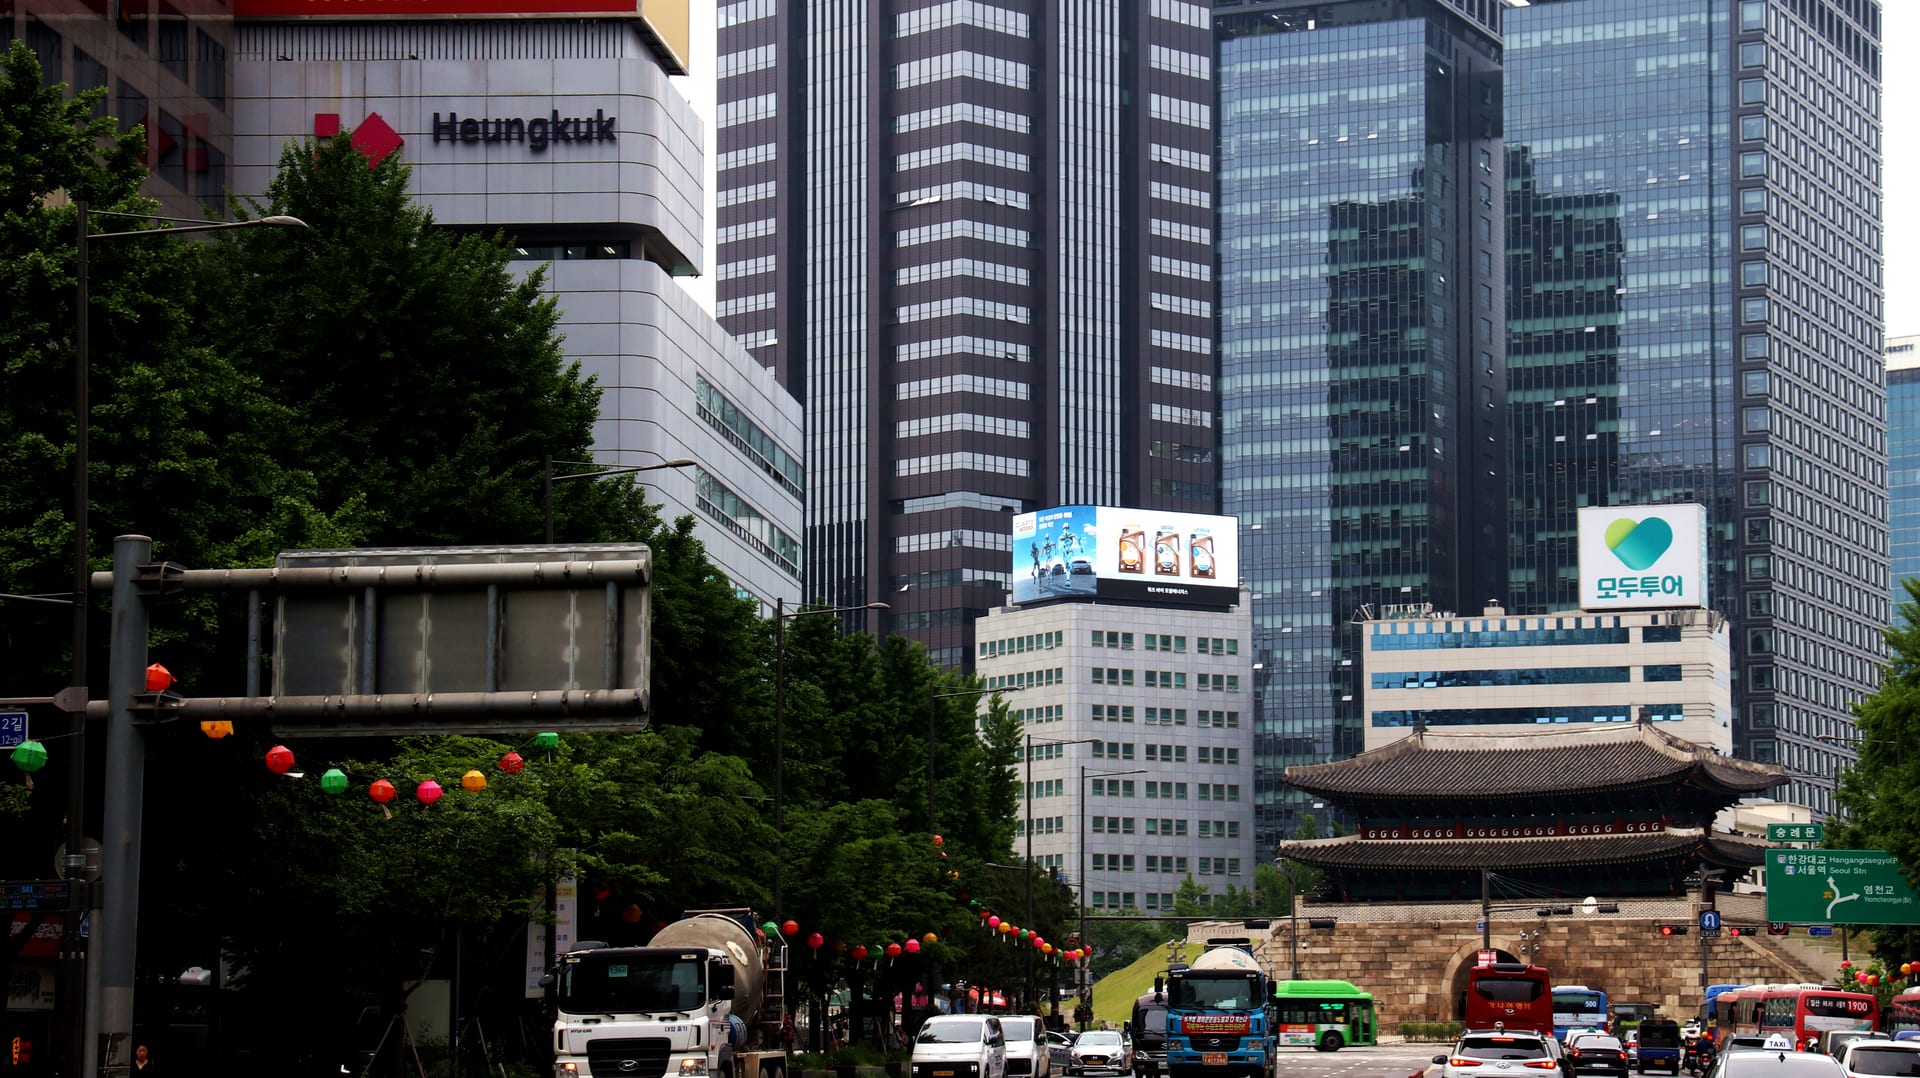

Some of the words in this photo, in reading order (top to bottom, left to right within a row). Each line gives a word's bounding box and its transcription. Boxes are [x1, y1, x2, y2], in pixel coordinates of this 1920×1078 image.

[433, 109, 616, 151] Heungkuk
[1597, 575, 1683, 599] 모두투어
[1788, 854, 1827, 865] 한강대교
[1797, 865, 1827, 875] 서울역
[1829, 867, 1851, 875] Seoul
[1853, 867, 1867, 875] Stn
[1863, 885, 1895, 895] 염천교
[1585, 1000, 1597, 1008] 500
[1847, 1001, 1868, 1011] 1900
